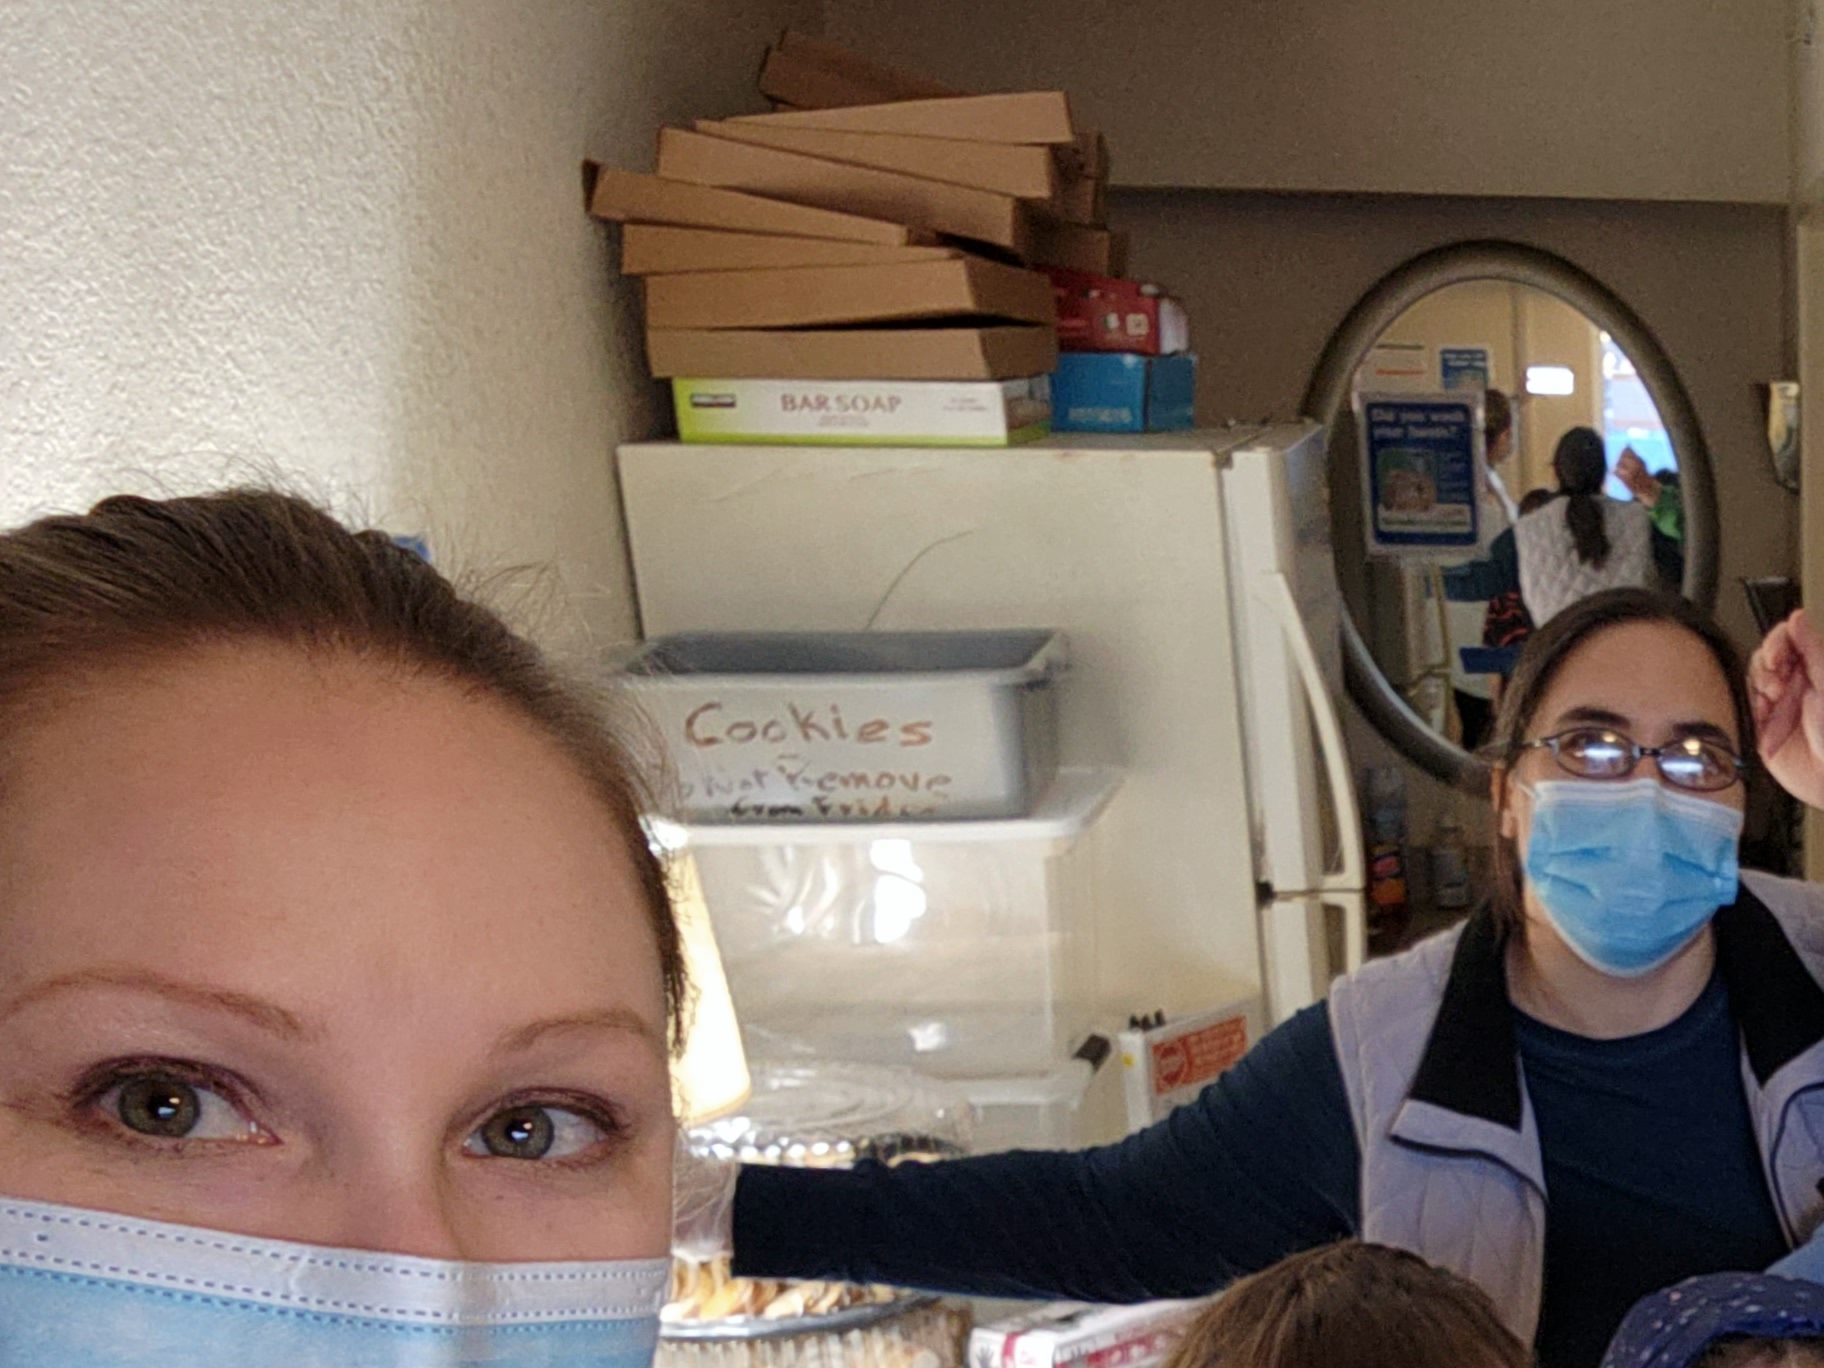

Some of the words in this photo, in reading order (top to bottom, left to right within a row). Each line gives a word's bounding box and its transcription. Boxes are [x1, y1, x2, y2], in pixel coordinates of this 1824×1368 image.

[781, 393, 829, 413] BAR
[837, 394, 903, 413] SOAP
[684, 699, 934, 749] Cookies
